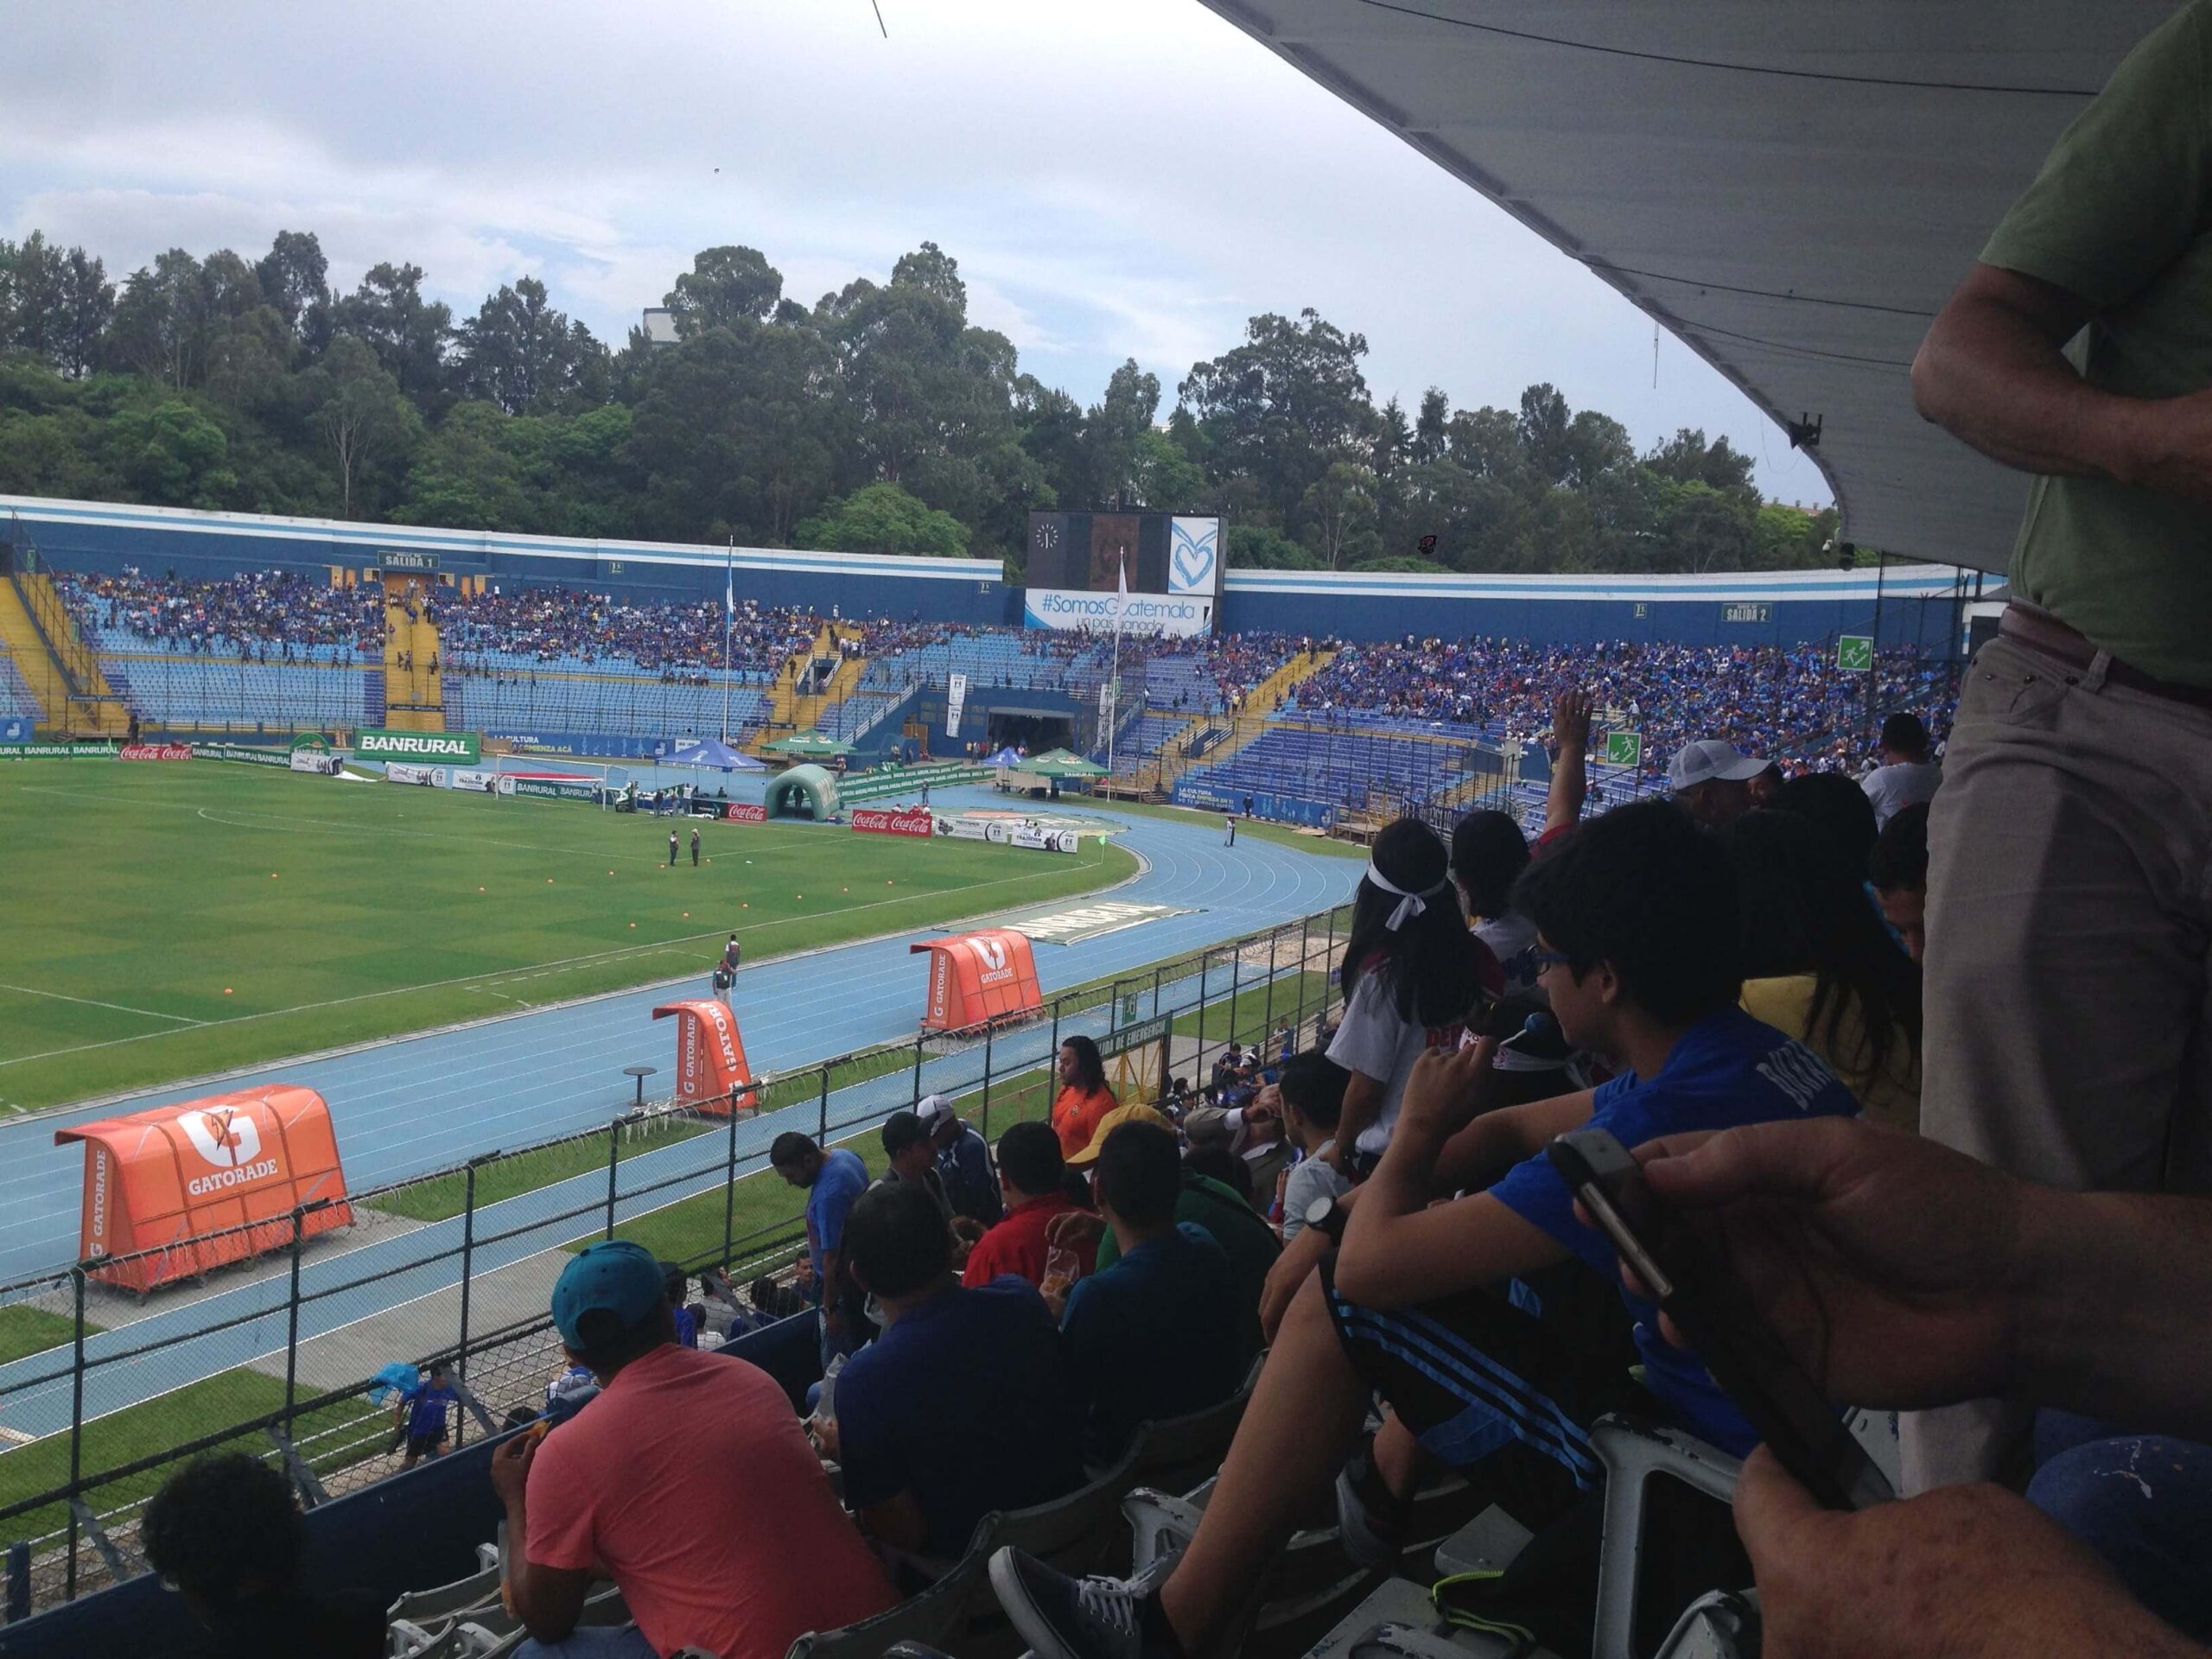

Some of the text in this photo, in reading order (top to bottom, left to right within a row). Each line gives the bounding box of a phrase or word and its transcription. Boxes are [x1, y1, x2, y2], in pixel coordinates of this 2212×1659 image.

[385, 556, 432, 568] SALIDA 1
[1727, 608, 1766, 620] SALIDA 2
[361, 735, 470, 755] BANRURAL
[193, 748, 222, 758] BANRURAL
[226, 749, 257, 760] BANRURAL
[257, 752, 290, 764] BANRURAL
[518, 784, 556, 796] BANRURAL
[561, 788, 593, 798] BANRURA
[1001, 902, 1167, 938] ANRURAL
[936, 954, 946, 1003] GATORADE
[981, 968, 1014, 983] GATORADE
[934, 1007, 944, 1017] G
[1127, 1020, 1166, 1046] EMERGENCIA
[683, 1015, 696, 1094] G GATORADE
[188, 1159, 278, 1196] GATORADE
[93, 1150, 106, 1237] GATORADE
